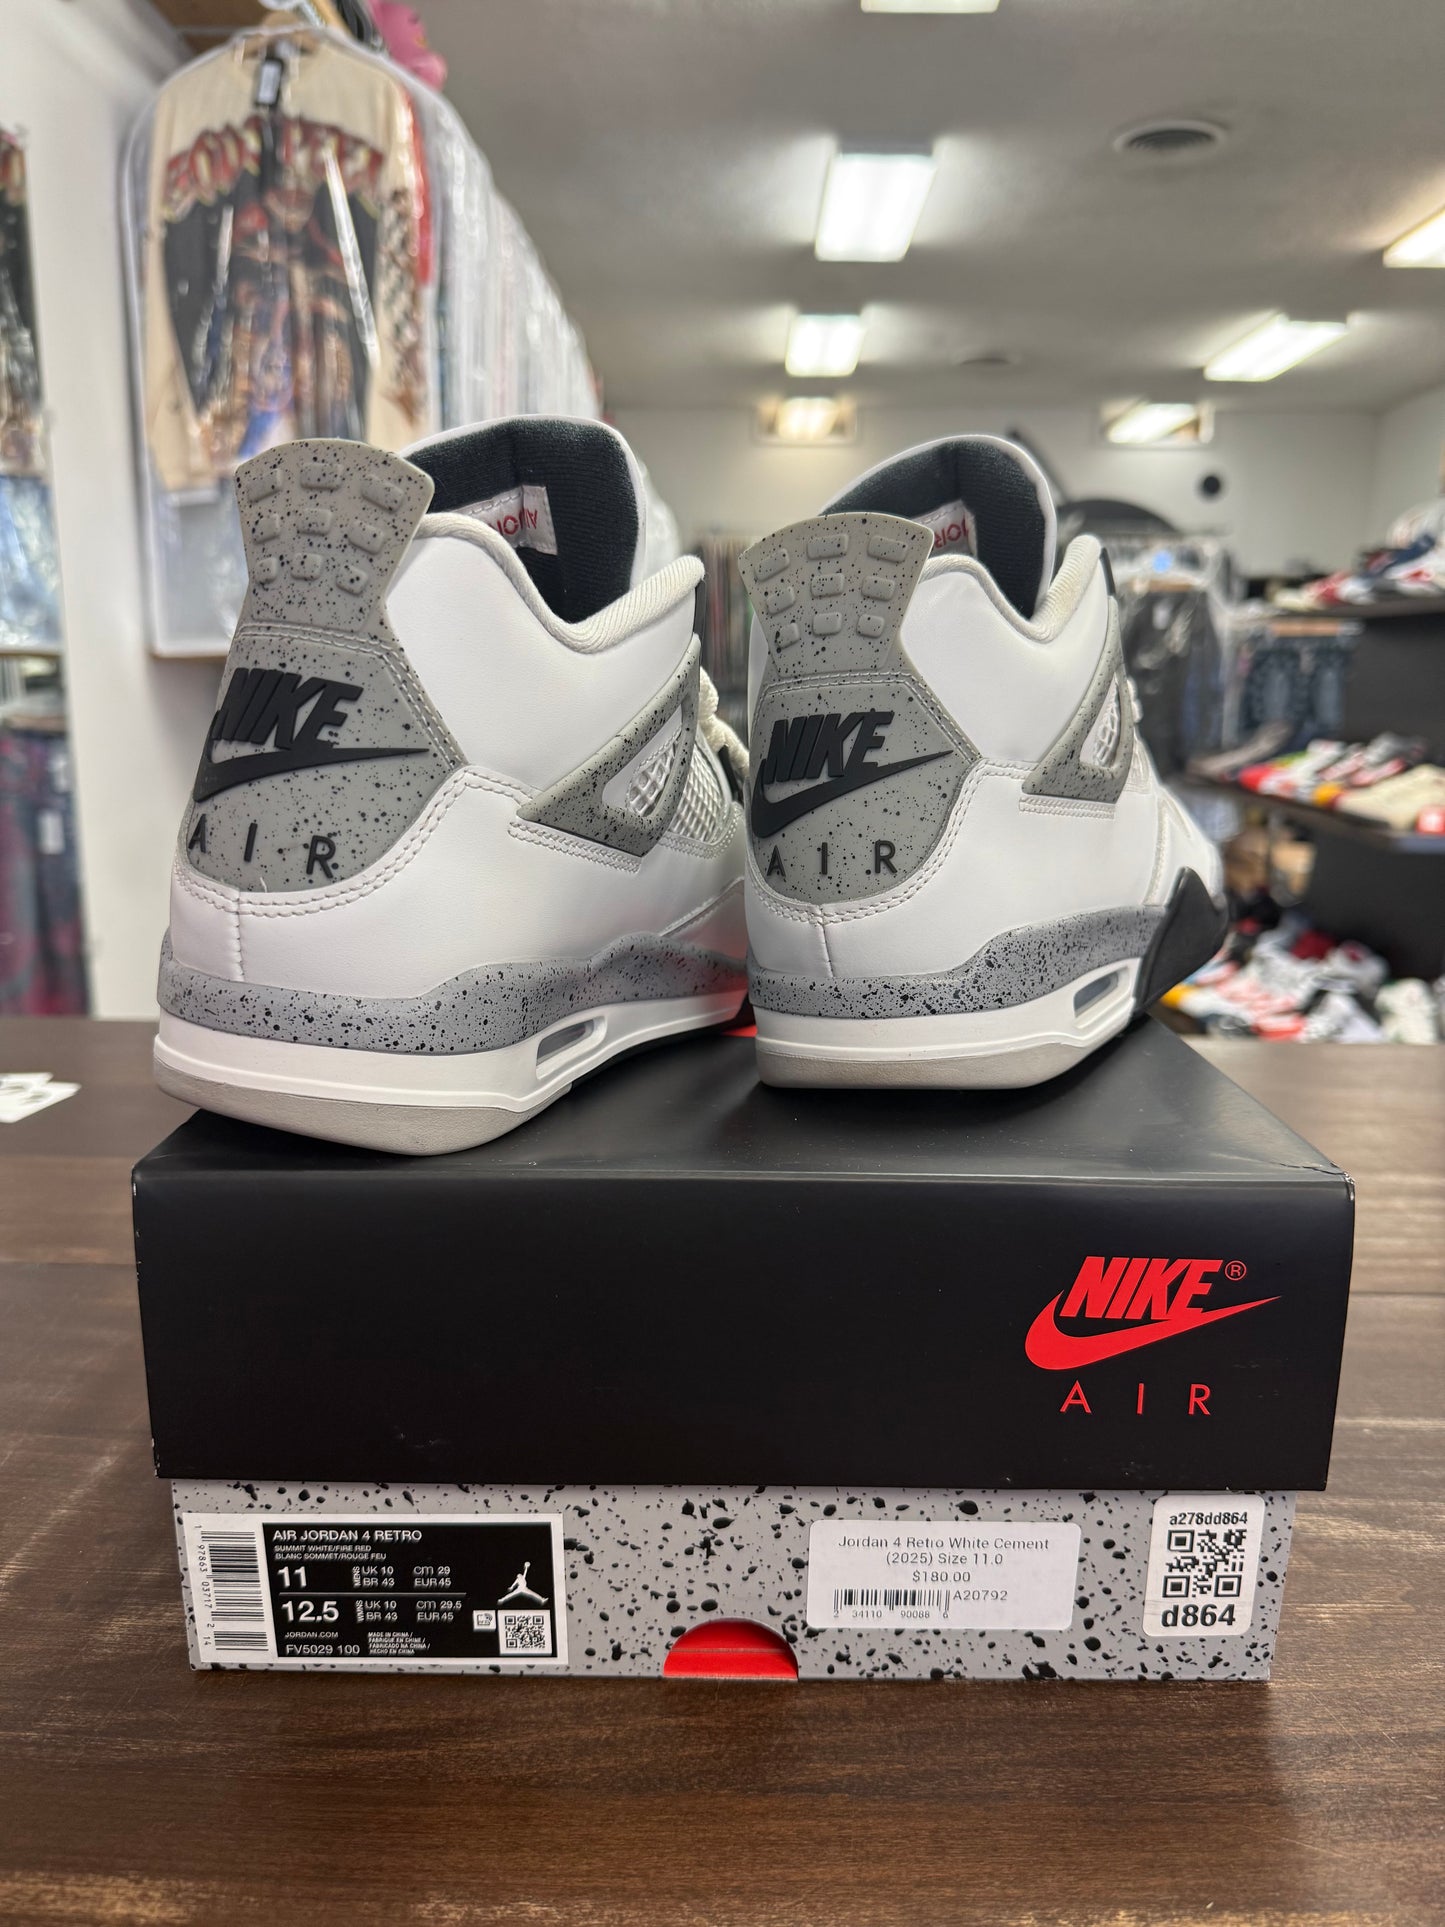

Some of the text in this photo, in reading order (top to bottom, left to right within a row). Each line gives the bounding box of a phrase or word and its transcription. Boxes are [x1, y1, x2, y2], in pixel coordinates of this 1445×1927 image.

[209, 667, 364, 750] NIKE
[763, 709, 895, 785] NIKE
[188, 813, 334, 878] AIR
[766, 840, 898, 877] AIR
[1059, 1256, 1223, 1321] NIKE
[1059, 1380, 1212, 1416] AIR
[1169, 1511, 1248, 1526] a278dd864
[272, 1529, 423, 1543] AIR JORDAN 4 RETRO
[838, 1536, 1049, 1550] Jordan 4 Retro White Cement
[273, 1544, 372, 1553] SUMMIT WHITE/FIRE RED
[196, 1544, 208, 1573] 97863
[275, 1552, 387, 1561] BLANC SOMMET/ROUGE FEU
[886, 1552, 1003, 1566] (2025) Size 11.0
[277, 1566, 308, 1588] 11
[352, 1565, 362, 1588] MENS
[361, 1565, 394, 1576] UK 10
[437, 1565, 451, 1576] 29
[912, 1571, 971, 1583] $180.00
[362, 1577, 396, 1587] BR 43
[414, 1577, 452, 1587] EUR 45
[201, 1581, 213, 1609] 03717
[953, 1590, 1008, 1601] A20792
[281, 1600, 340, 1623] 12.5
[364, 1600, 397, 1610] UK 10
[439, 1600, 462, 1611] 29.5
[366, 1611, 398, 1621] BR 43
[417, 1611, 454, 1622] EUR 45
[852, 1610, 882, 1618] 34110
[1161, 1604, 1236, 1627] d864
[285, 1631, 339, 1639] JORDAN.COM
[285, 1644, 361, 1656] FV5029 100
